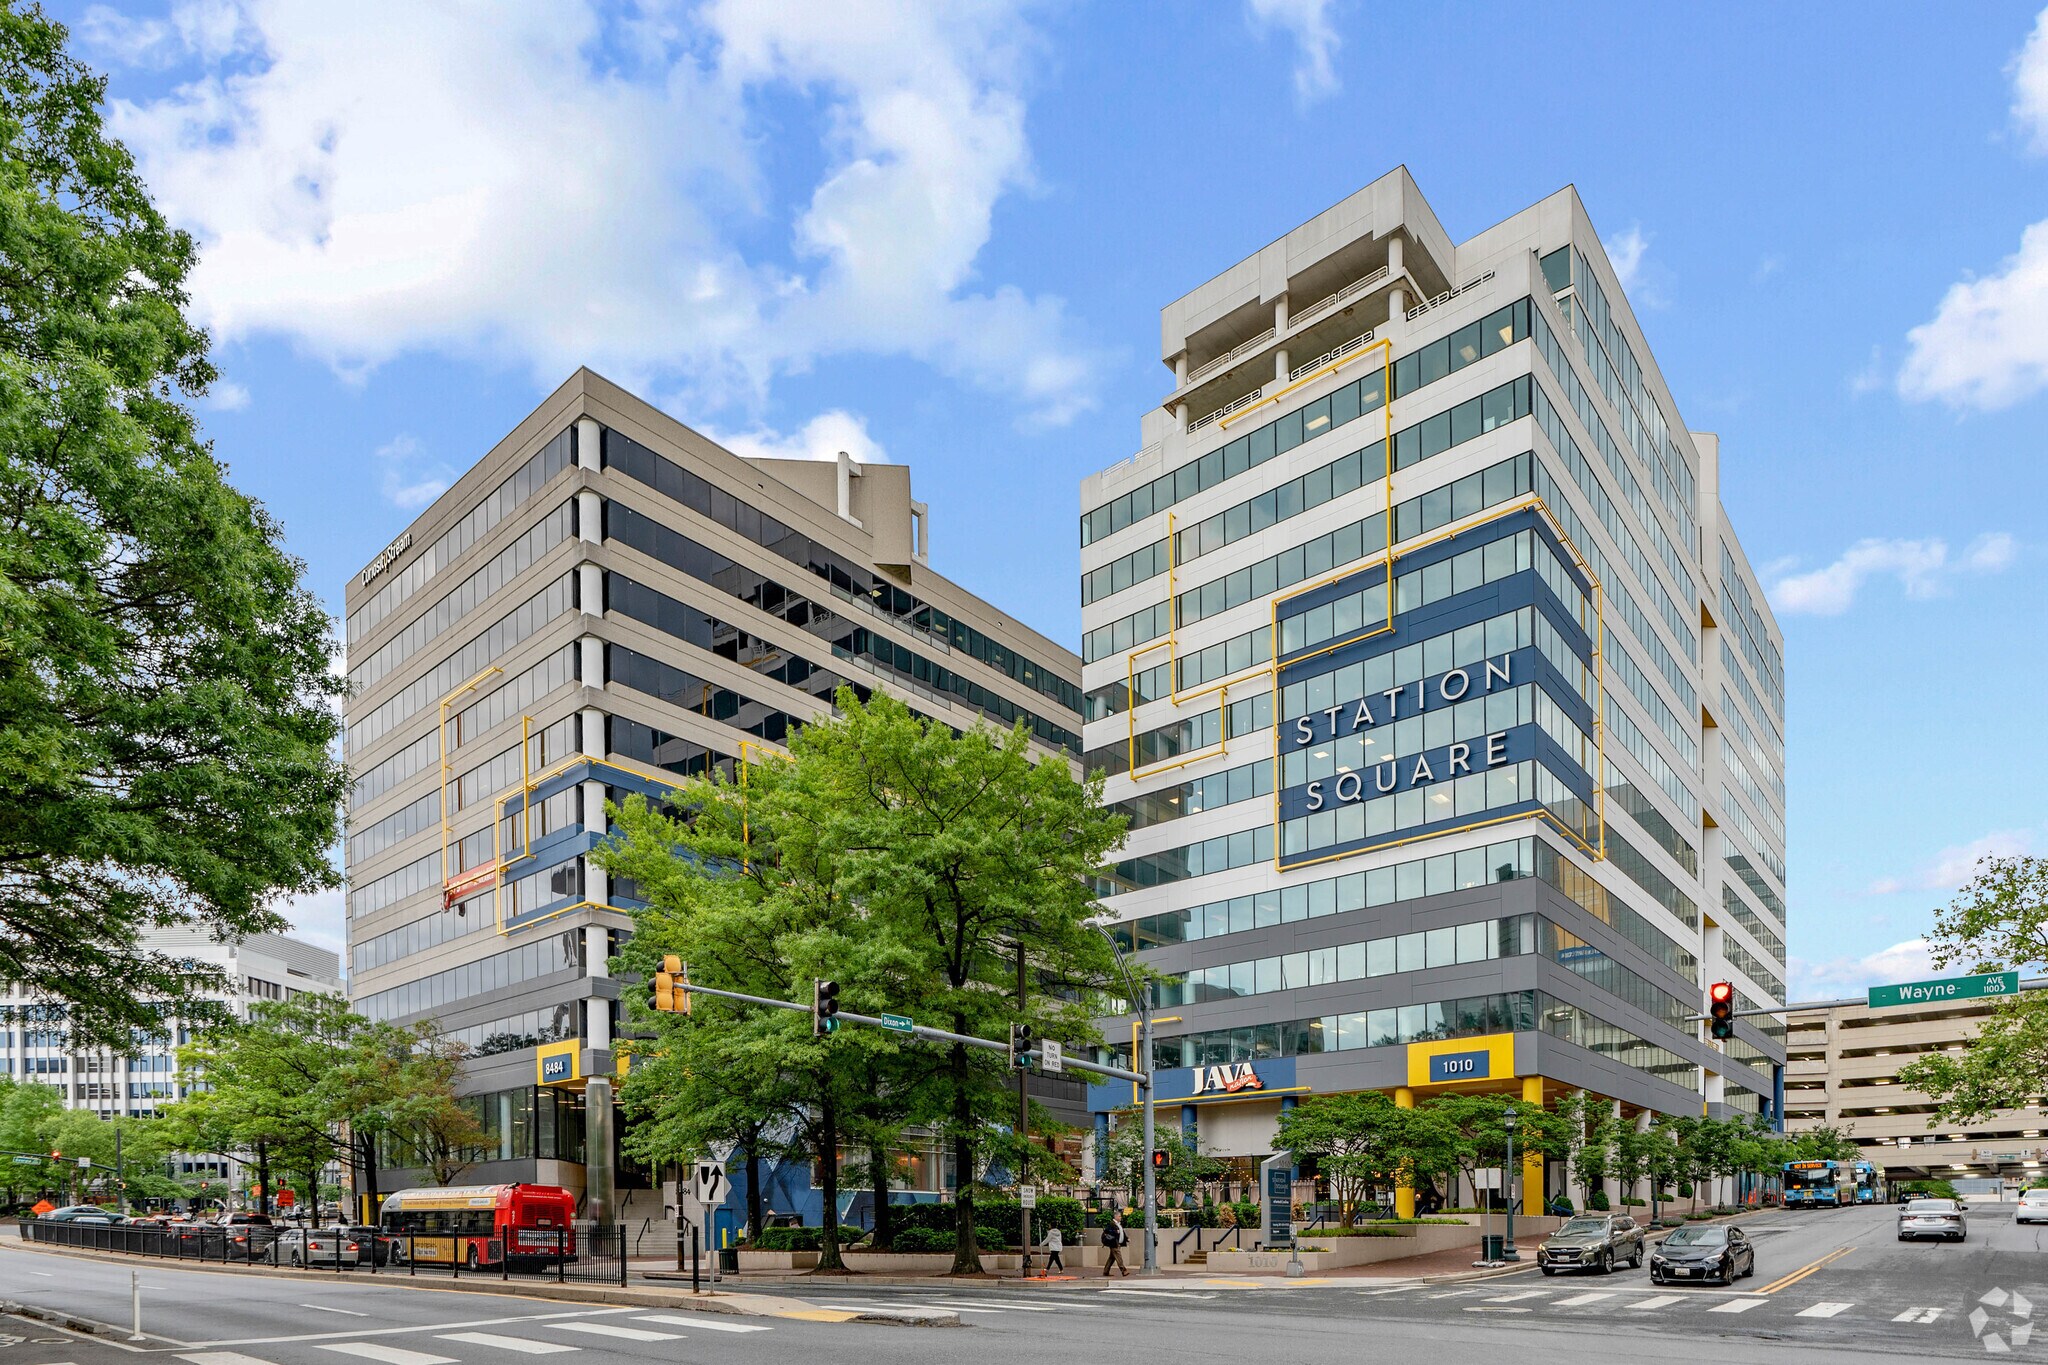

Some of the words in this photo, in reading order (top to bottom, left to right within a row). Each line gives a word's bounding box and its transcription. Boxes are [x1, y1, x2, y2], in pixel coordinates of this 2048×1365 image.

[362, 533, 411, 586] CuriosityStream
[1296, 654, 1510, 744] STATION
[1306, 732, 1508, 811] SQUARE
[1986, 976, 2003, 985] AVE
[1899, 984, 1956, 1000] Wayne
[1983, 985, 2000, 993] 1100
[883, 1016, 899, 1027] Dixon
[545, 1061, 564, 1075] 8484
[1443, 1059, 1473, 1073] 1010
[1192, 1062, 1256, 1094] JAVA
[1230, 1076, 1253, 1090] nation
[1247, 1256, 1279, 1268] 1010
